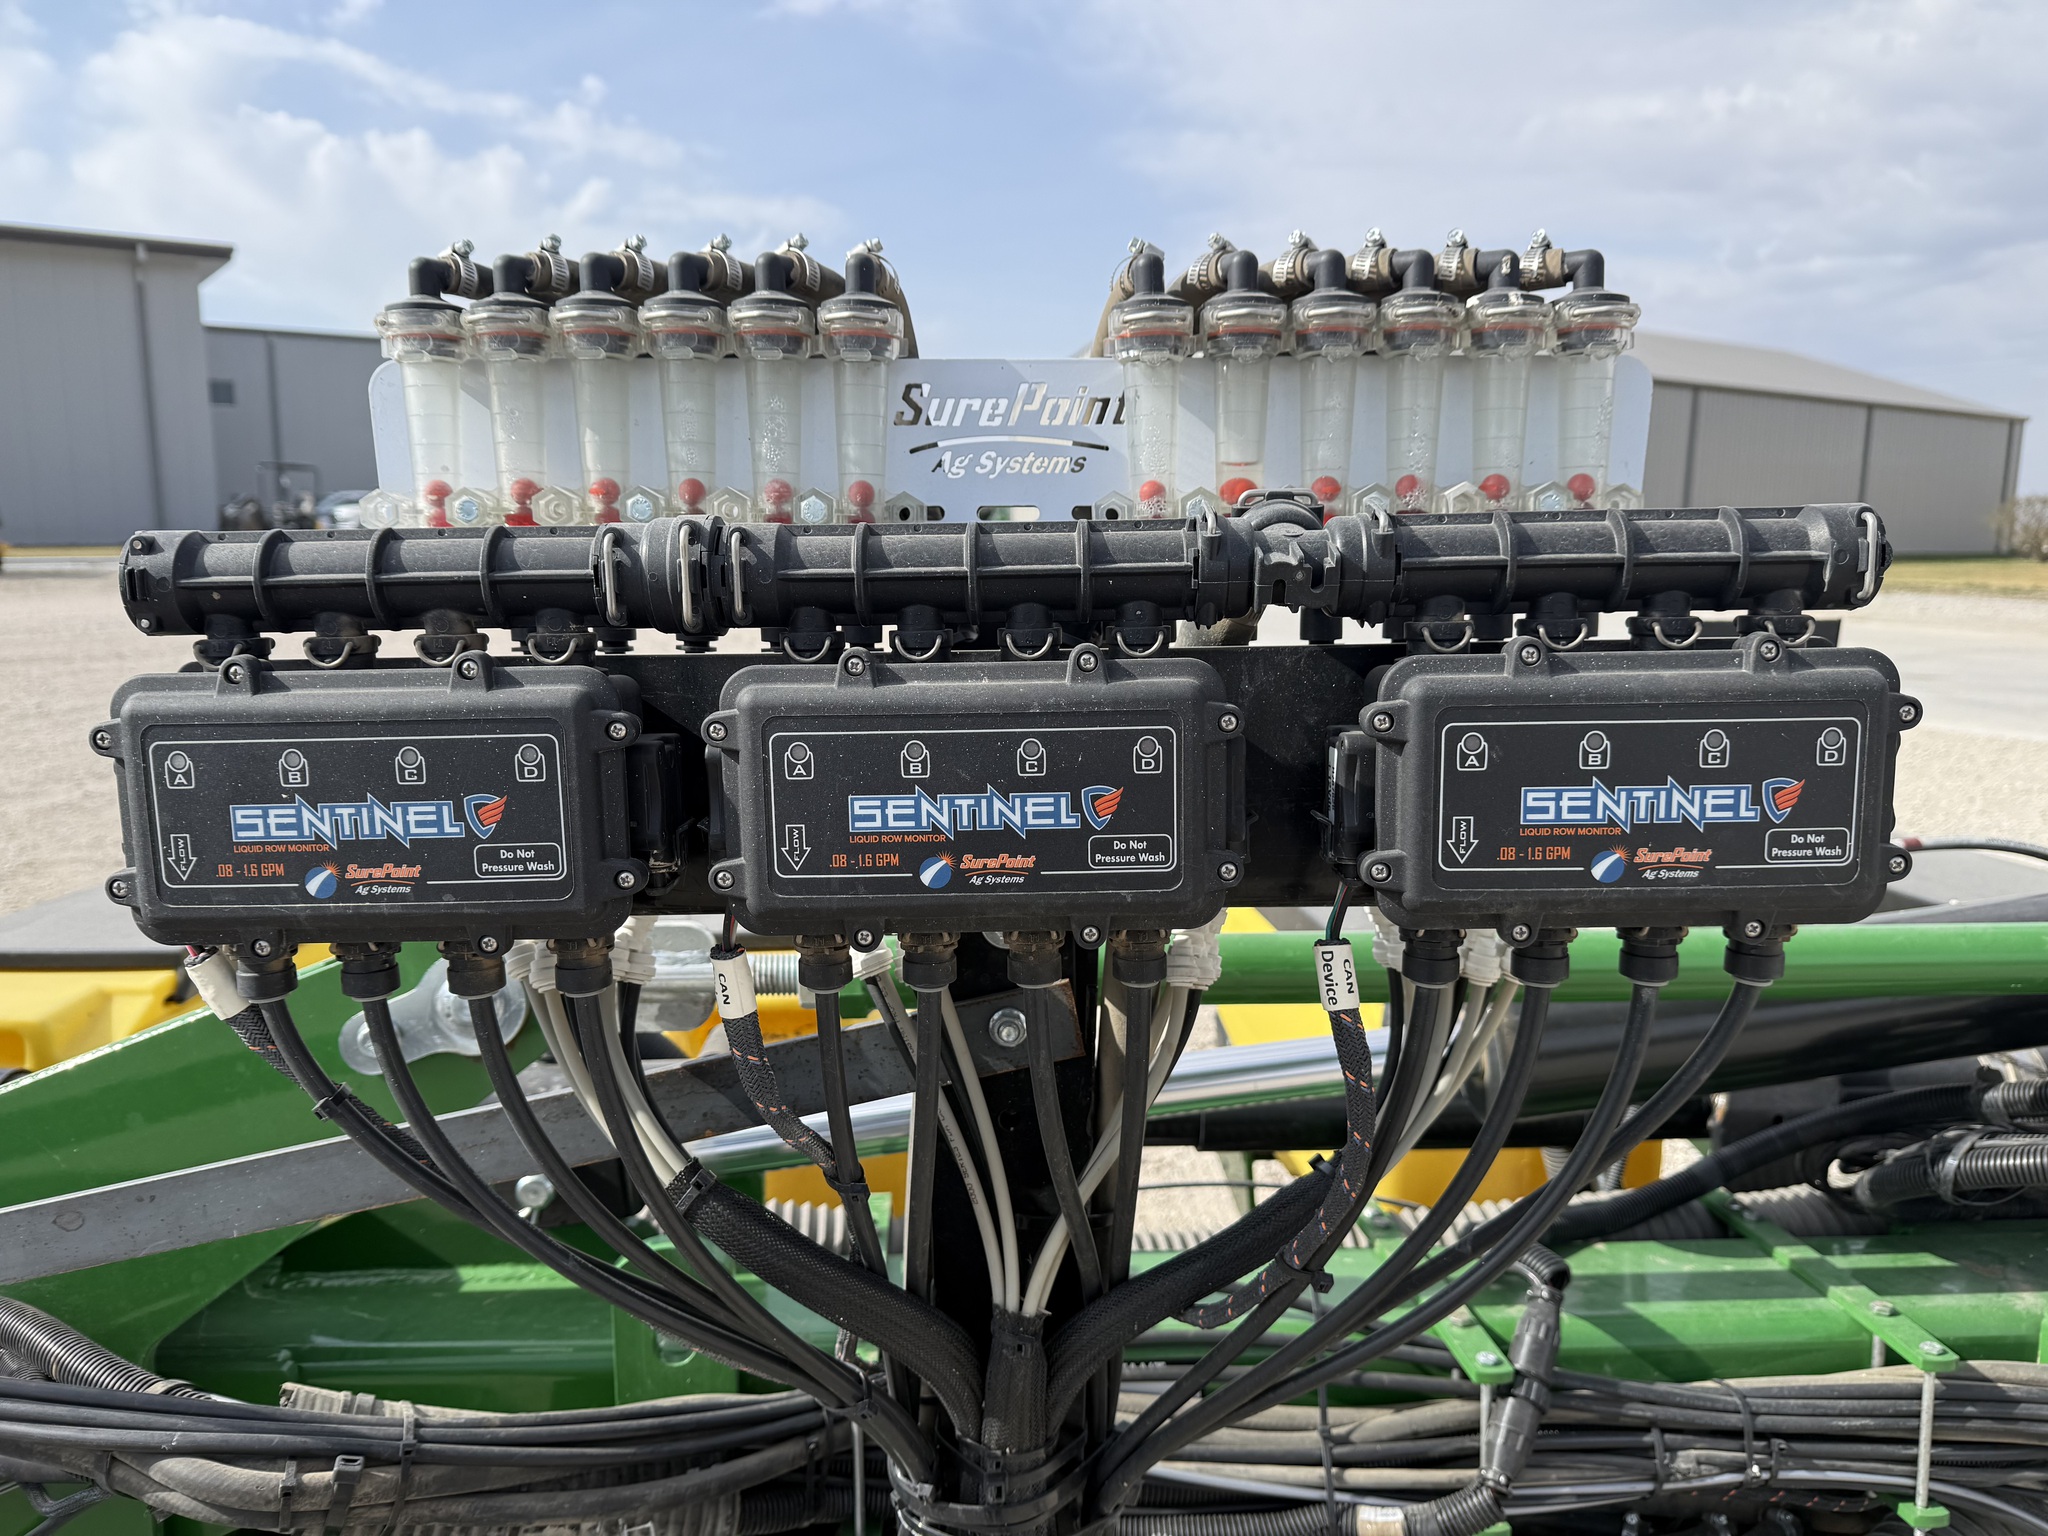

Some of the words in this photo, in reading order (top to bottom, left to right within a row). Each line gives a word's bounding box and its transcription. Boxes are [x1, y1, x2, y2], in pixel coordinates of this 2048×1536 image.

[931, 450, 975, 479] Ag
[975, 450, 1087, 480] Systems
[1465, 756, 1479, 766] A
[1588, 755, 1601, 765] B
[1709, 753, 1720, 763] C
[1825, 751, 1838, 761] D
[910, 763, 921, 773] B
[1026, 762, 1037, 771] C
[1142, 759, 1154, 769] D
[405, 770, 417, 780] C
[524, 767, 538, 777] D
[793, 765, 806, 775] A
[174, 773, 187, 785] A
[288, 772, 300, 783] B
[1520, 775, 1760, 833] SENTINEL
[849, 784, 1080, 840] SENTINEL
[230, 793, 464, 849] SENTINEL
[1520, 828, 1550, 836] LIQUID
[1553, 827, 1575, 836] ROW
[1577, 827, 1622, 835] MONITOR
[850, 835, 879, 844] LIQUID
[881, 835, 902, 843] ROW
[904, 834, 946, 842] MONITOR
[1790, 834, 1803, 844] Do
[1806, 834, 1825, 844] Not
[234, 845, 262, 853] LIQUID
[265, 844, 286, 852] ROW
[288, 843, 329, 852] MONITOR
[1113, 840, 1125, 850] Do
[1129, 840, 1147, 849] Not
[500, 849, 512, 858] Do
[516, 849, 535, 858] Not
[1095, 853, 1136, 863] Pressure
[1138, 853, 1165, 862] Wash
[1496, 847, 1515, 861] .08
[1528, 847, 1543, 860] 1.6
[1546, 846, 1570, 860] GPM
[1633, 847, 1712, 863] SurePoint
[1771, 847, 1813, 858] Pressure
[1815, 847, 1842, 857] Wash
[830, 854, 846, 867] .08
[859, 853, 873, 867] 1.6
[876, 853, 900, 866] GPM
[960, 854, 1037, 868] SurePoint
[216, 864, 233, 877] .08
[261, 862, 284, 876] GPM
[344, 863, 422, 879] SurePoint
[482, 862, 524, 872] Pressure
[526, 861, 555, 871] Wash
[1641, 869, 1656, 879] Ag
[1658, 868, 1699, 878] Systems
[968, 875, 983, 885] Ag
[985, 874, 1025, 884] Systems
[355, 885, 369, 895] Ag
[371, 883, 411, 894] Systems
[1321, 950, 1338, 1006] Device
[1343, 958, 1355, 994] CAN
[718, 973, 731, 1005] CAN
